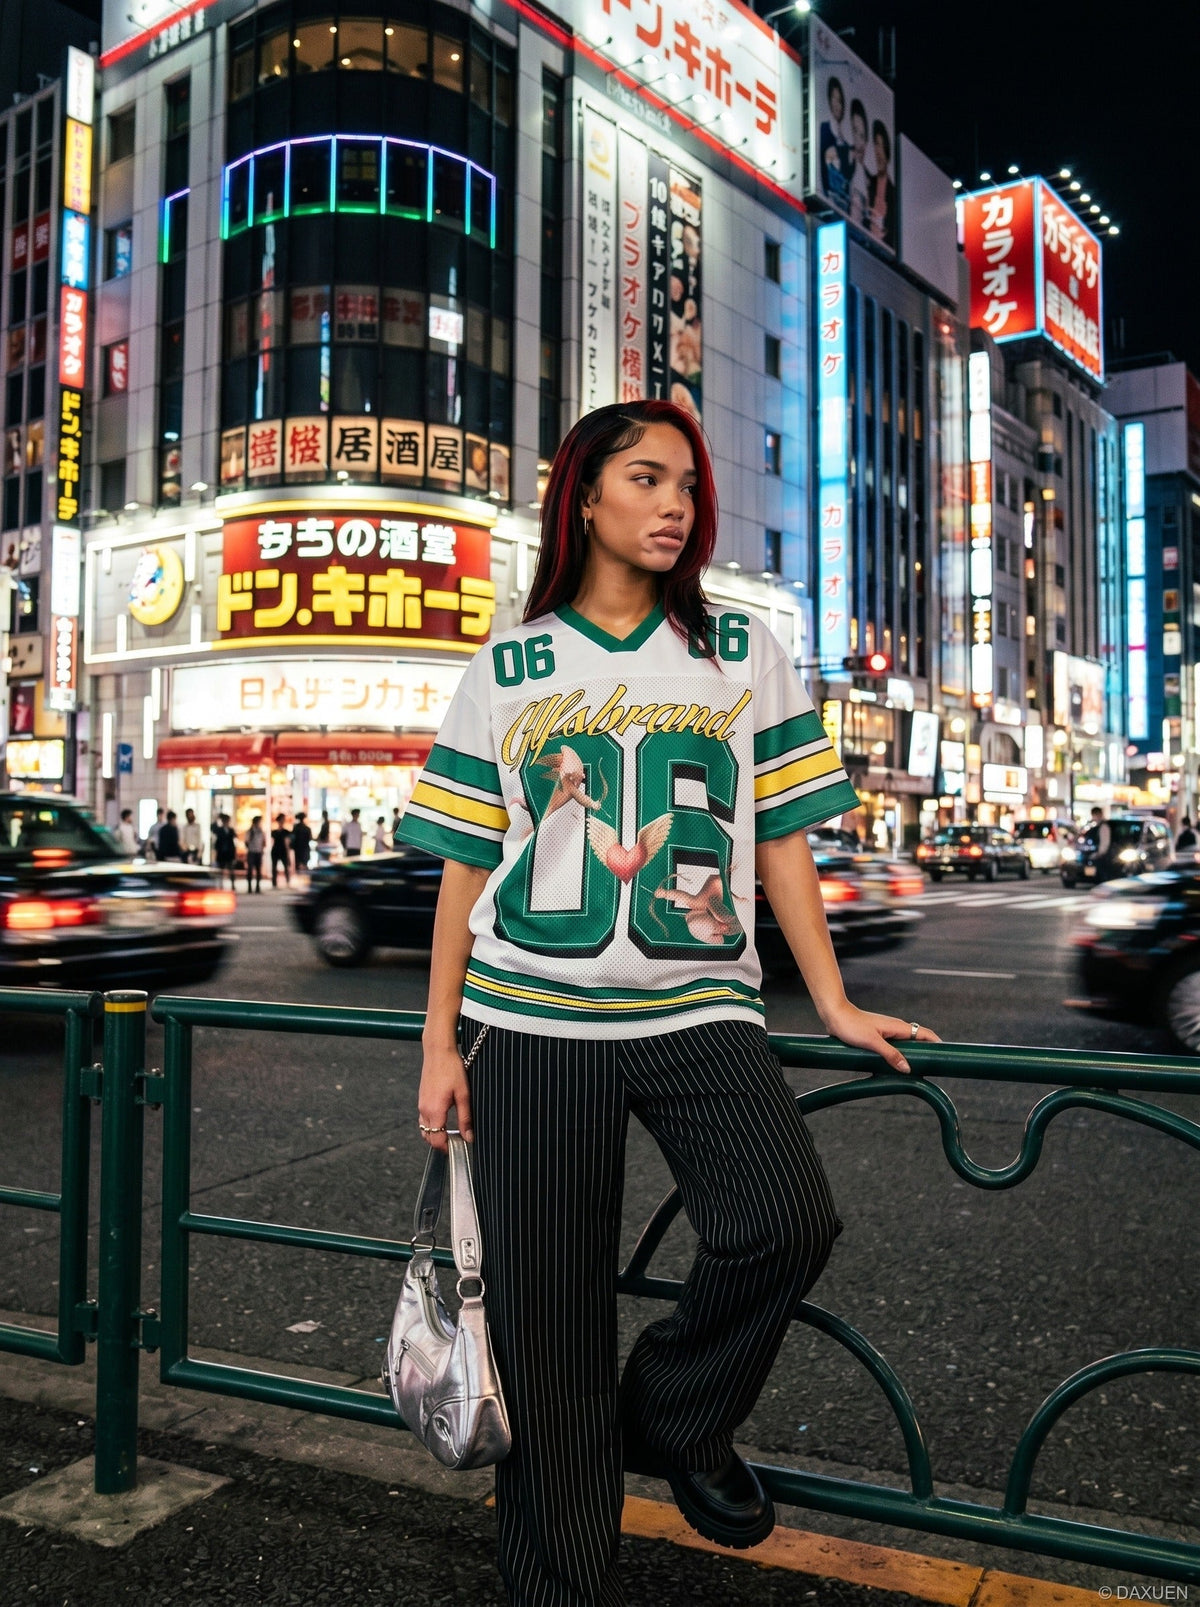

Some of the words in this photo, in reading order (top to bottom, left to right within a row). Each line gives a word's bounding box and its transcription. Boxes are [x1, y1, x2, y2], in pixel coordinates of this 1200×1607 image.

[823, 252, 842, 375] カラオケ
[981, 195, 1018, 335] カラオケ
[823, 505, 843, 632] カラオケ
[492, 633, 556, 688] 06
[493, 724, 748, 961] 06
